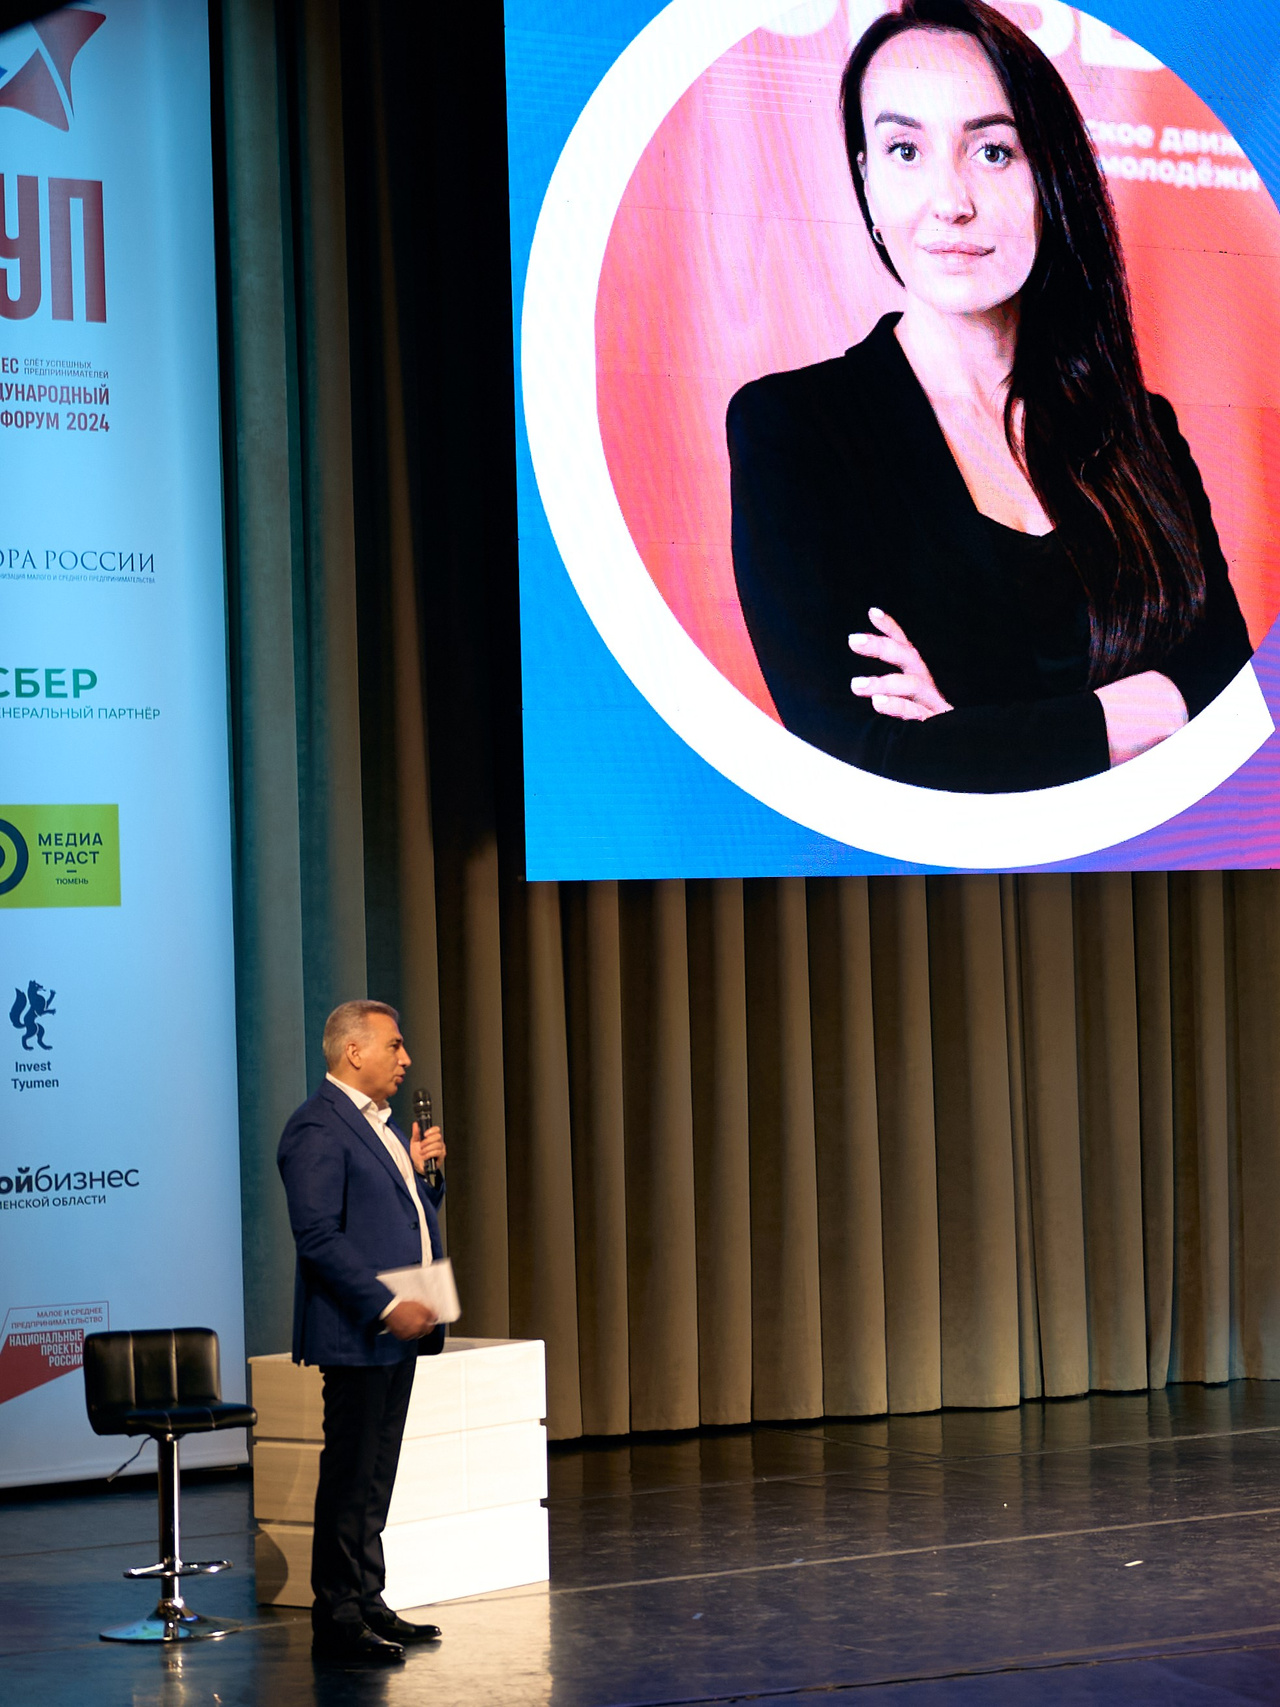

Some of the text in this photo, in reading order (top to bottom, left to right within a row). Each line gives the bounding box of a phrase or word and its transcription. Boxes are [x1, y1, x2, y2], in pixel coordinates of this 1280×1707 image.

[46, 359, 92, 369] УСПЕШНЫХ
[24, 367, 109, 379] ПРЕДПРИНИМАТЕЛЕЙ
[66, 411, 110, 432] 2024
[0, 549, 155, 573] РА РОССИИ
[0, 706, 161, 720] НЕРАЛЬНЫЙ ПАРТНЁР
[38, 833, 103, 847] МЕДИА
[42, 851, 100, 865] ТРАСТ
[15, 1061, 52, 1073] Invest
[11, 1079, 60, 1092] Tyumen
[0, 1195, 106, 1210] ЕНСКОЙ ОБЛАСТИ
[37, 1310, 63, 1318] МАЛОЕ
[71, 1307, 103, 1316] СРЕДНЕЕ
[11, 1316, 103, 1329] ПРЕДПРИНИМАТЕЛЬСТВО
[9, 1330, 82, 1347] НАЦИОНАЛЬНЫЕ
[41, 1343, 83, 1356] ПРОЕКТЫ
[49, 1355, 83, 1367] РОССИИ
